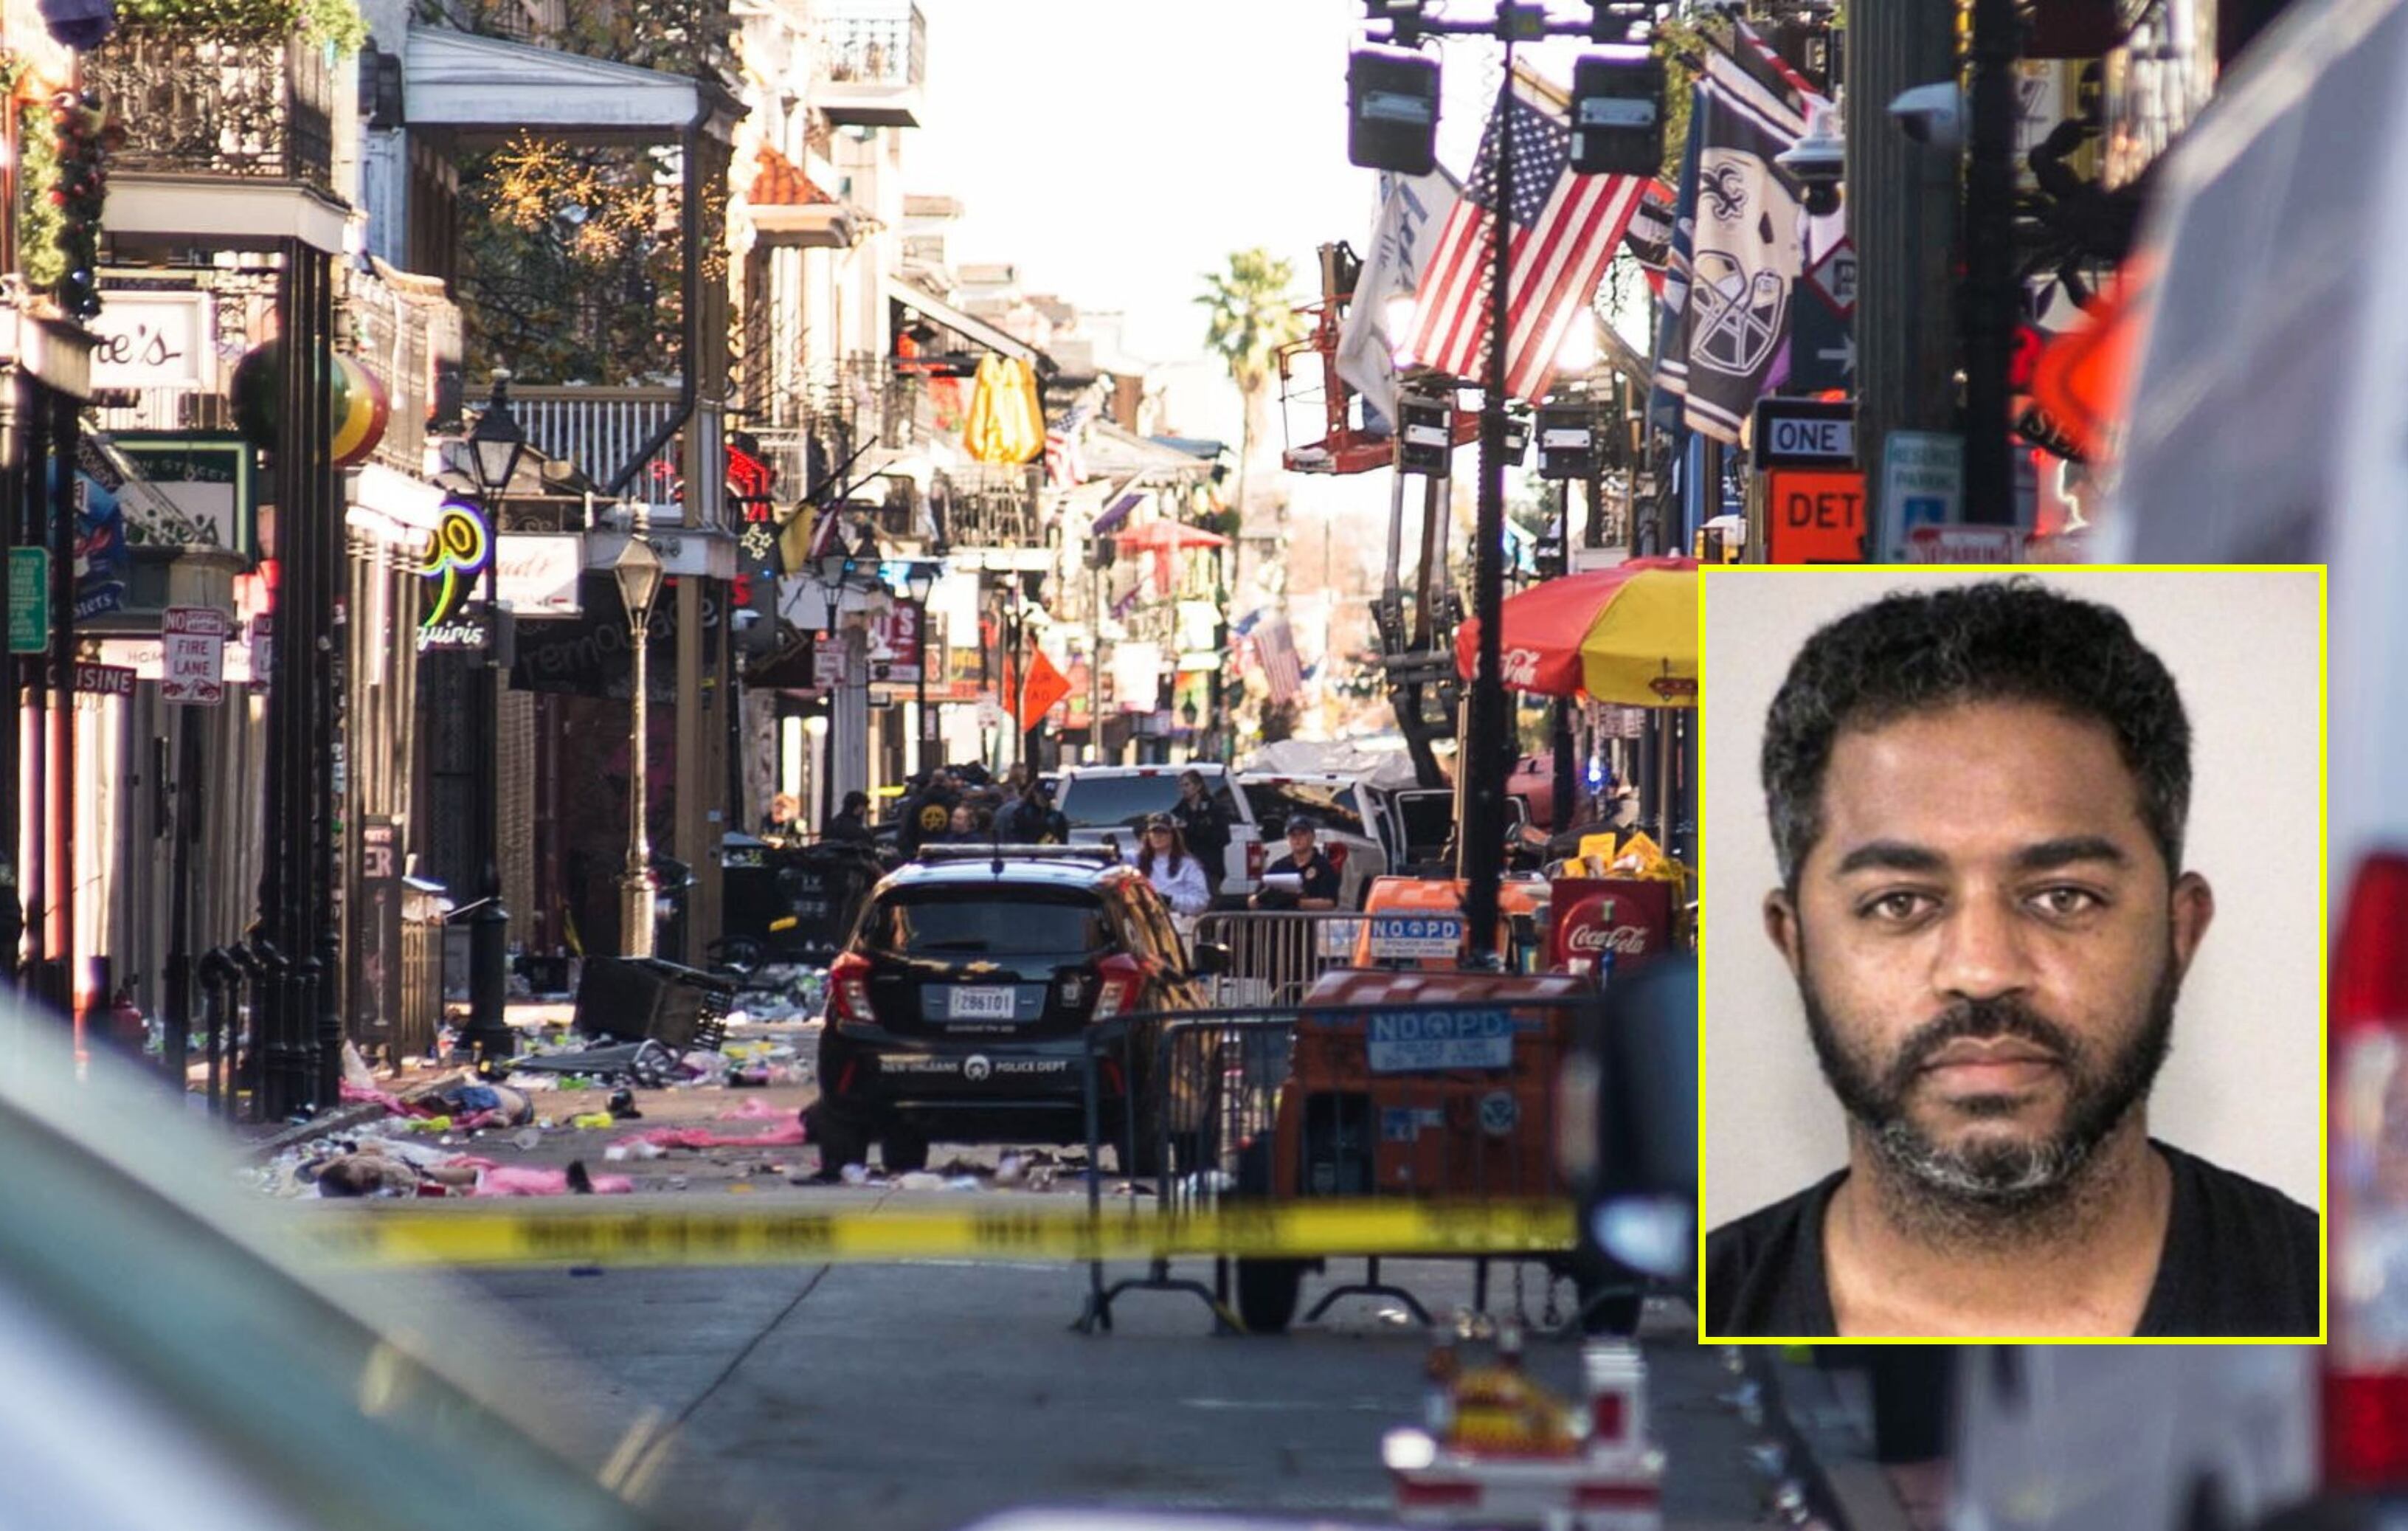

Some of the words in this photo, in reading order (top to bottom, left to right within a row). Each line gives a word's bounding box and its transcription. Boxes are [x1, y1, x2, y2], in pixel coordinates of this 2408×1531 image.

[1777, 422, 1838, 452] ONE
[1788, 492, 1860, 528] DET
[165, 612, 184, 631] NO
[177, 639, 209, 656] FIRE
[417, 621, 485, 652] quiris
[521, 598, 719, 680] remouae
[173, 660, 210, 676] LANE
[996, 1062, 1034, 1072] POLICE
[1037, 1060, 1068, 1071] DEPT
